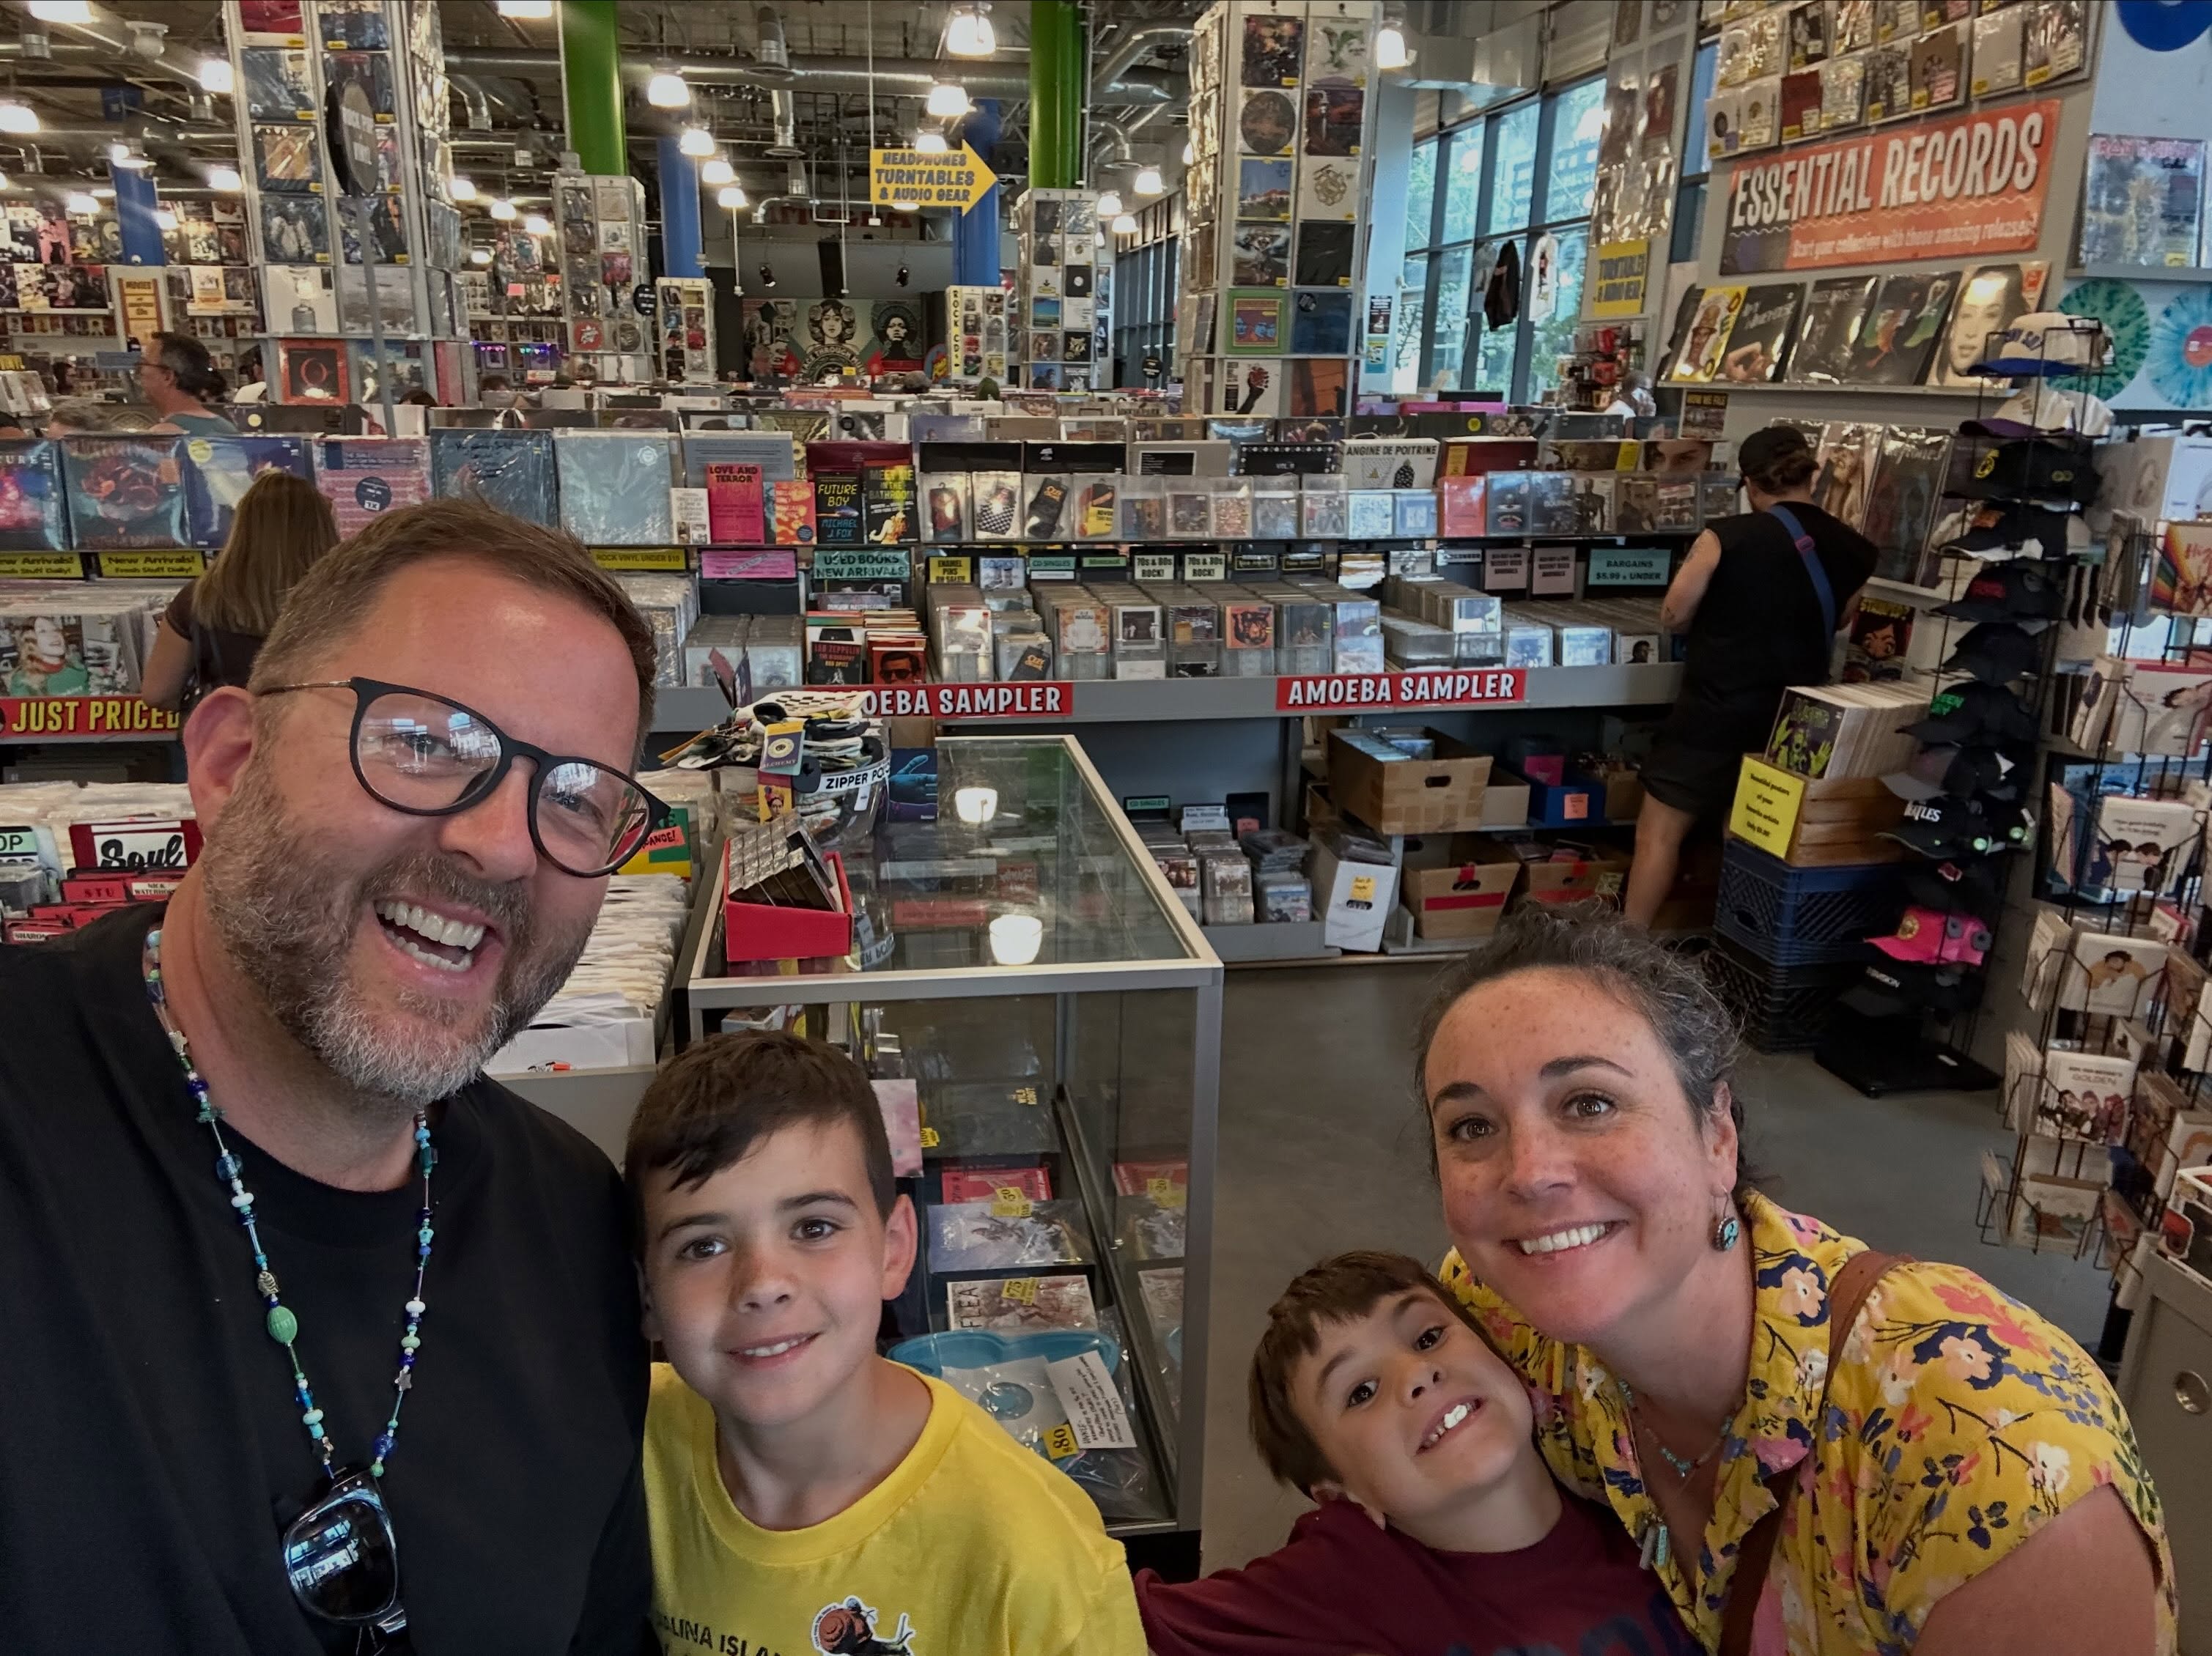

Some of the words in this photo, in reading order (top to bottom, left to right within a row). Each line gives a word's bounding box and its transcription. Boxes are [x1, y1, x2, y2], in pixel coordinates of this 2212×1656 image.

[882, 152, 967, 167] HEADPHONES
[1732, 144, 1873, 229] ESSENTIAL
[1879, 111, 2045, 210] RECORDS
[875, 169, 976, 186] TURNTABLES
[880, 187, 888, 200] &
[893, 188, 932, 201] AUDIO
[936, 188, 971, 202] GEAR
[1346, 446, 1382, 456] ANGINE
[1382, 446, 1393, 455] DE
[1395, 445, 1437, 456] POITRINE
[709, 465, 735, 475] LOVE
[737, 466, 759, 475] AND
[715, 475, 753, 484] TERROR
[818, 484, 858, 495] FUTURE
[827, 496, 850, 507] BOY
[822, 518, 858, 528] MICHAEL
[22, 556, 74, 565] Arrivals!
[144, 555, 195, 565] Arrivals!
[823, 555, 857, 566] USED
[858, 554, 900, 564] BOOKS
[1606, 559, 1654, 569] BARGAINS
[816, 568, 844, 577] NEW
[847, 566, 905, 577] ARRIVALS
[1141, 569, 1165, 578] ROCK!
[1192, 568, 1214, 577] ROCK!
[1629, 572, 1662, 581] UNDER
[1288, 677, 1392, 705] AMOEBA
[1400, 673, 1516, 703] SAMPLER
[862, 689, 932, 715] OEBA
[938, 687, 1061, 714] SAMPLER
[12, 701, 81, 733] JUST
[825, 773, 868, 790] ZIPPER
[100, 834, 184, 868] Soul
[958, 1287, 983, 1328] FLEA
